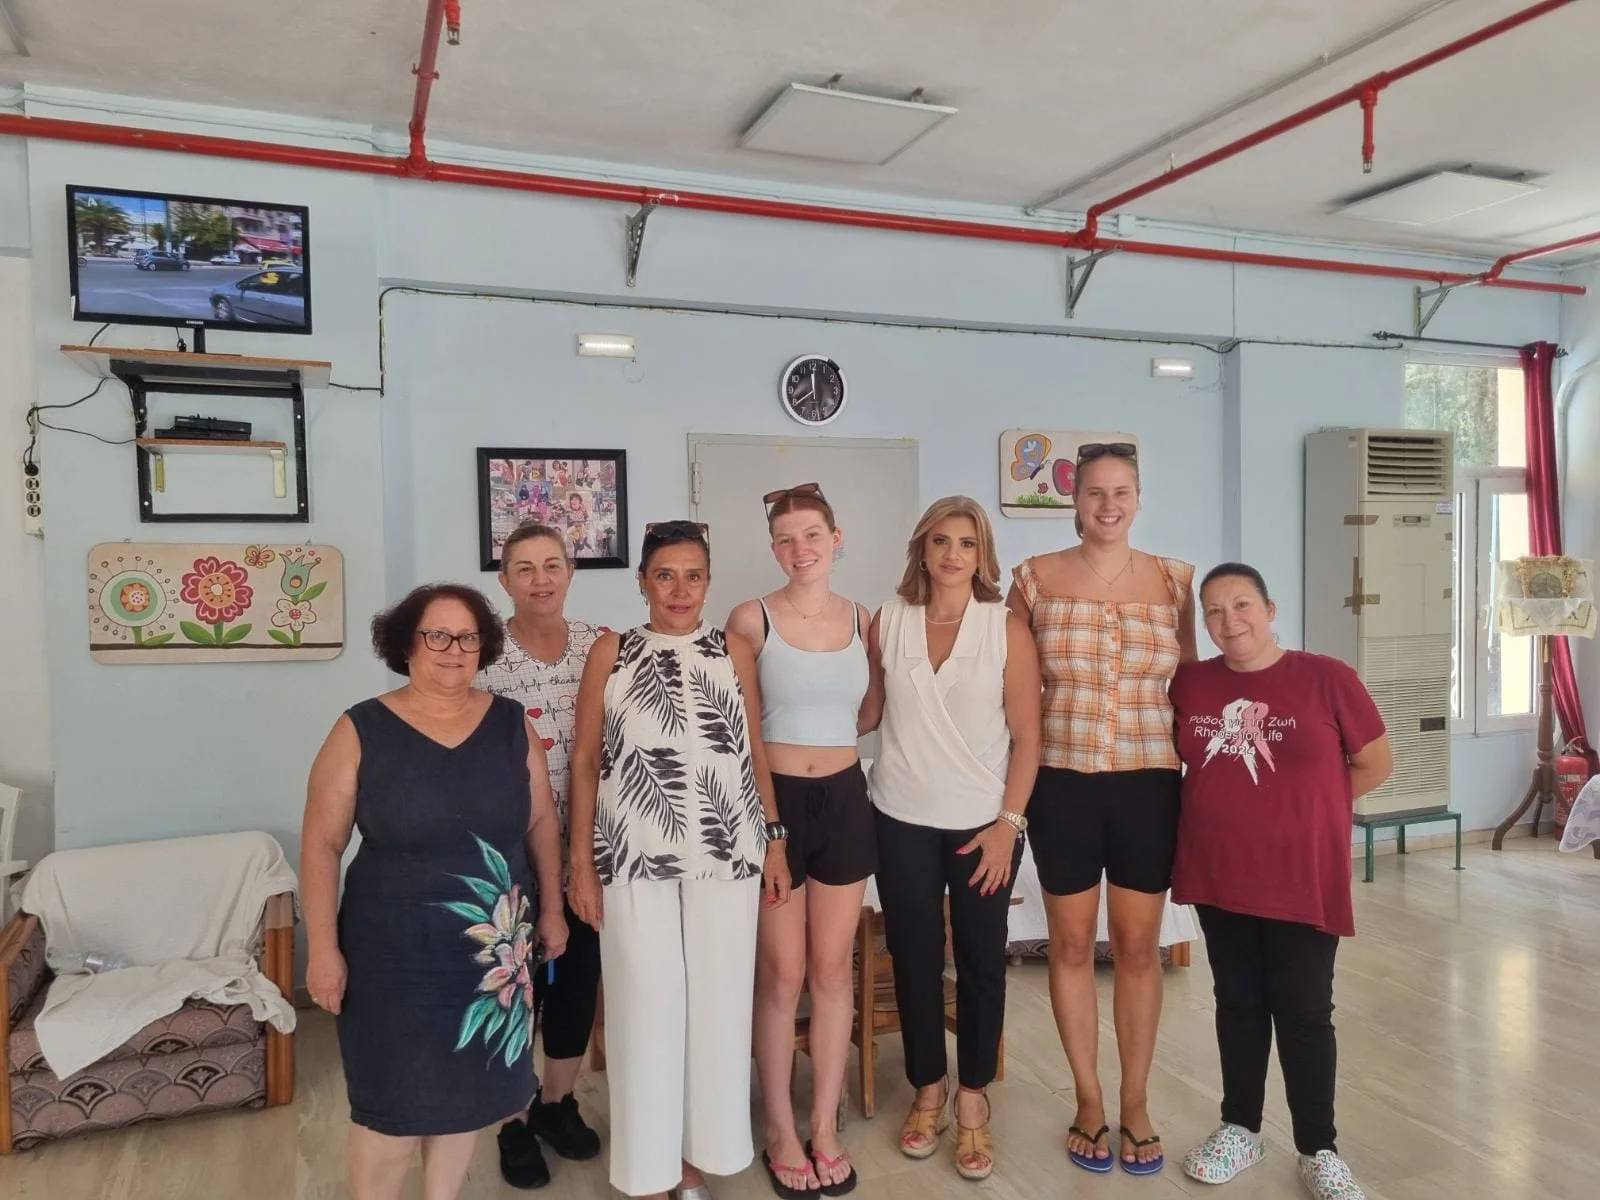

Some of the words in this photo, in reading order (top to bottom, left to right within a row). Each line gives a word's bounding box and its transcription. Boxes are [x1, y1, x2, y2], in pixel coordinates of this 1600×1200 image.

[809, 363, 817, 371] 12
[791, 375, 800, 383] 10
[788, 386, 794, 394] 9
[833, 386, 839, 395] 3
[1268, 716, 1296, 729] Ζωή
[1194, 726, 1239, 740] Rhodes
[1241, 729, 1257, 741] for
[1261, 730, 1283, 742] Life
[1221, 744, 1256, 755] 2024
